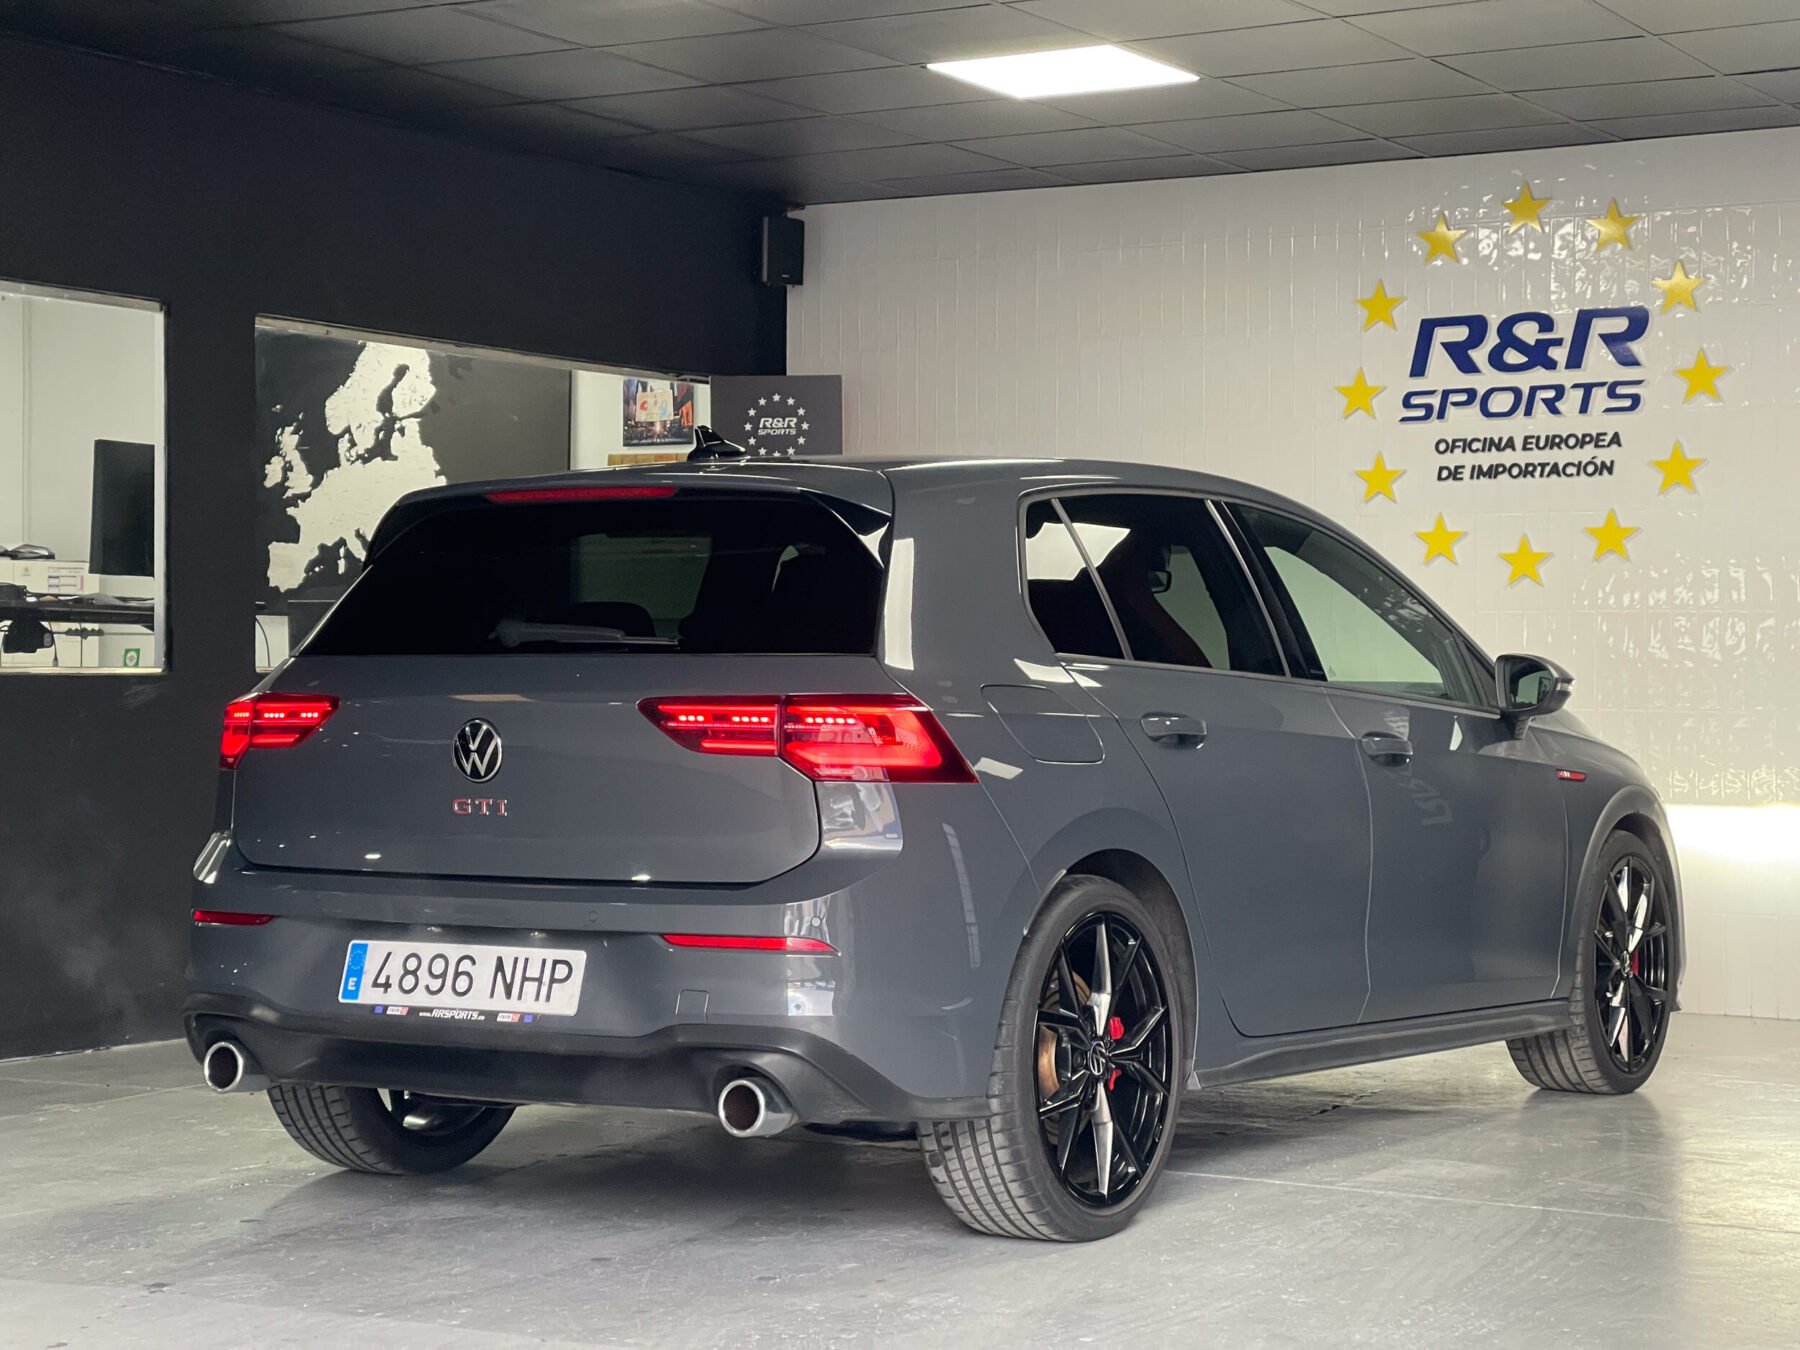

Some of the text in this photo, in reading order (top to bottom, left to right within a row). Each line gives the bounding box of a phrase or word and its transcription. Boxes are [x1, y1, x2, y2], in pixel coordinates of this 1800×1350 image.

[1408, 305, 1650, 379] R&R
[1399, 378, 1646, 423] SPORTS
[759, 417, 797, 428] R&R
[1434, 430, 1623, 456] OFICINA EUROPEA
[1436, 455, 1615, 482] DE IMPORTACIÓN
[452, 798, 508, 816] GTI
[347, 977, 358, 990] E
[371, 951, 573, 1003] 4896 NHP
